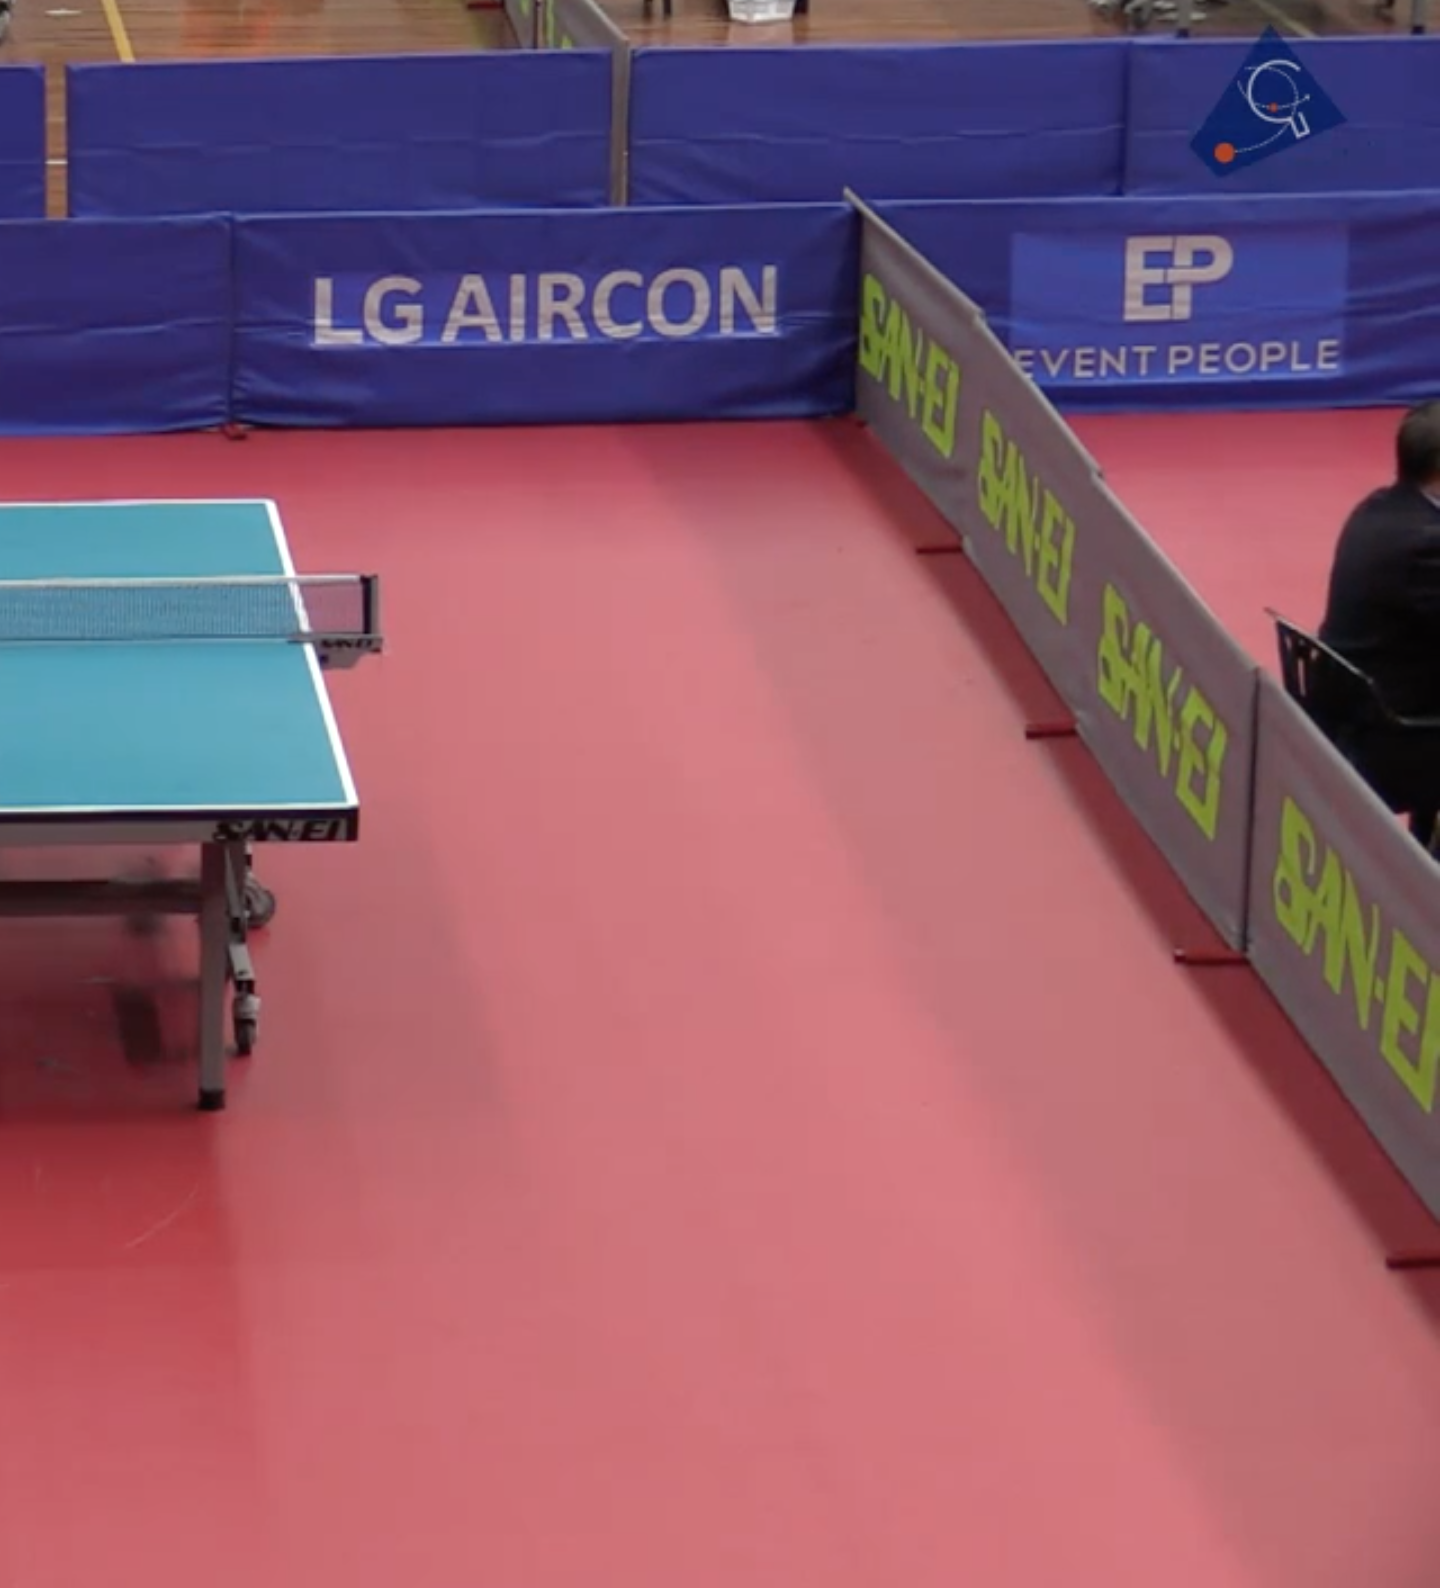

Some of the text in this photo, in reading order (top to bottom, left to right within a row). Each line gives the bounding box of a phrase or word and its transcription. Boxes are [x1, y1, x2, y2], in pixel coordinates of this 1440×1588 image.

[315, 265, 777, 345] LG AIRCON
[1124, 235, 1234, 322] EP
[1013, 339, 1340, 378] EVENT PEOPLE
